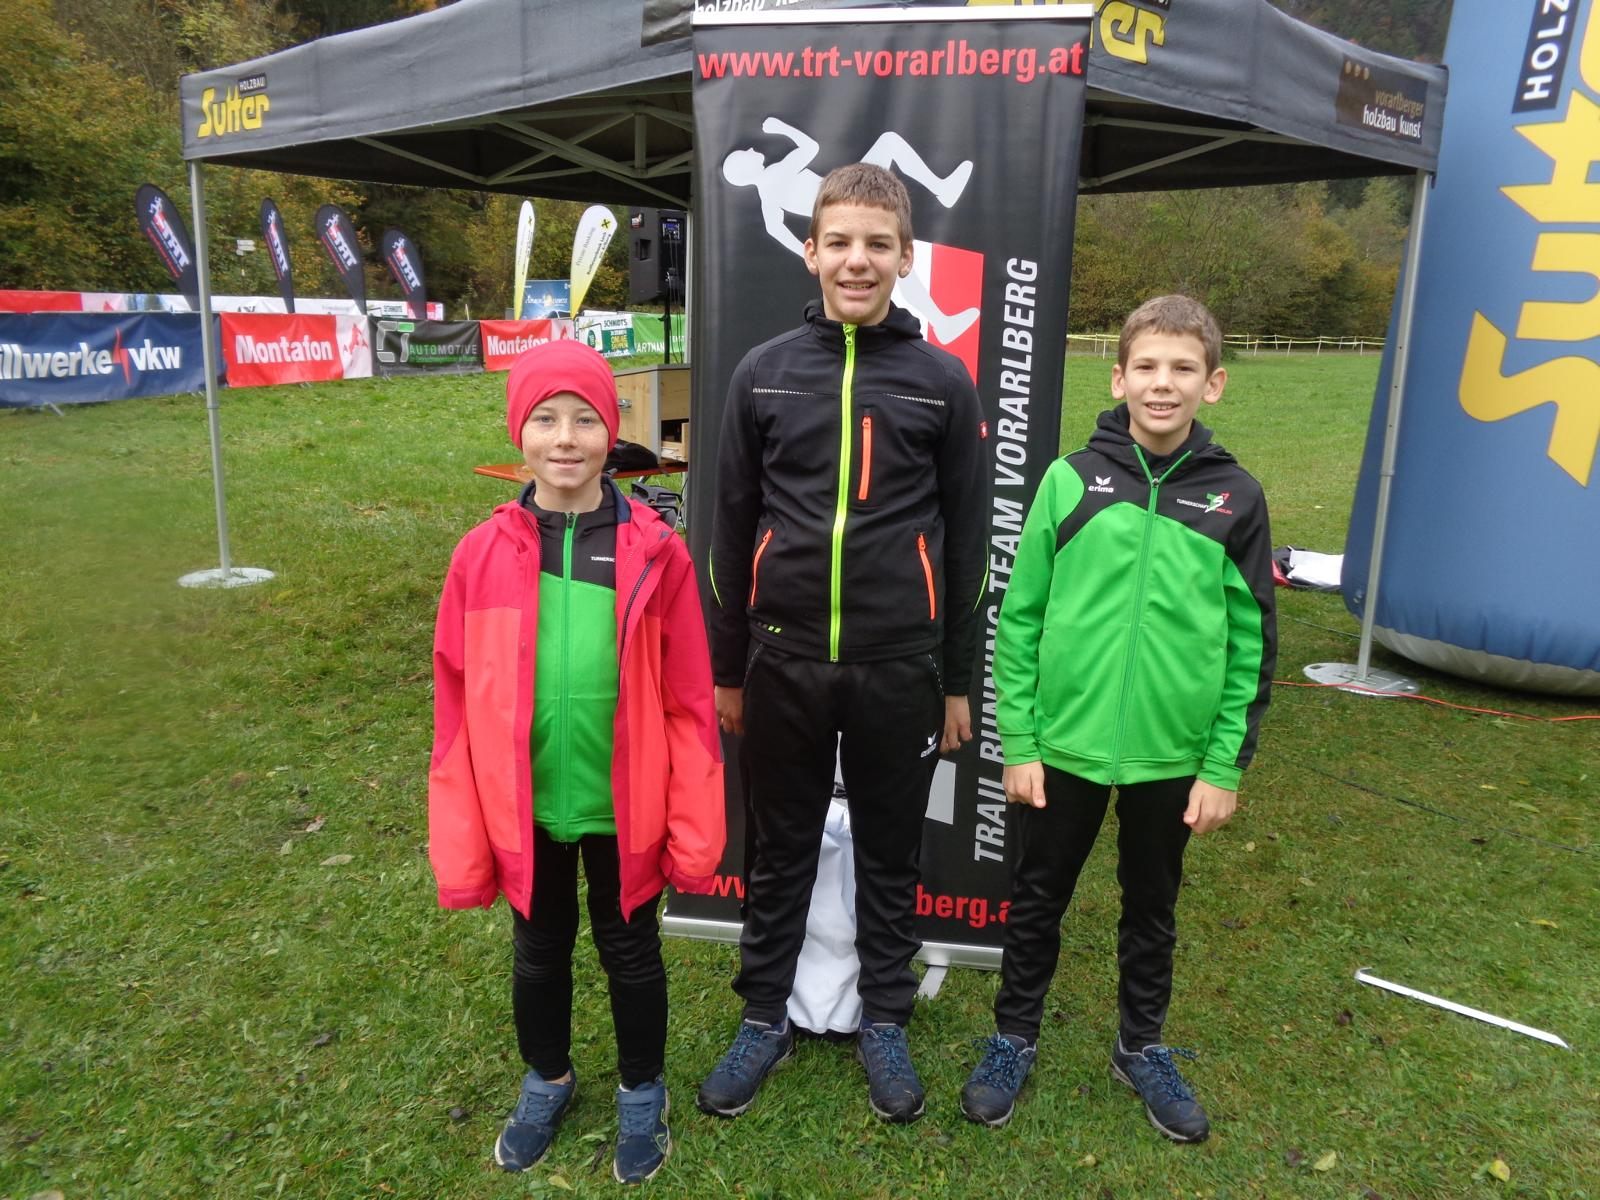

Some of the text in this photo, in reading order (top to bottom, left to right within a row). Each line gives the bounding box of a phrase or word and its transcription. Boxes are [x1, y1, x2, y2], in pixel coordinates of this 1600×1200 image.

[698, 40, 1083, 83] www.trt-vorarlberg.at
[239, 76, 267, 92] HOLZBAU
[197, 85, 270, 138] Sutter
[1362, 103, 1422, 139] holzbau kunst
[1375, 88, 1425, 118] vorarlberger
[1458, 0, 1600, 489] Sutt
[0, 342, 113, 380] llwerke
[128, 338, 181, 372] vkw
[235, 334, 334, 365] Montafon
[408, 344, 478, 356] AUTOMOTIVE
[994, 257, 1038, 486] VORARLBERG
[1088, 484, 1114, 493] erima
[988, 496, 1023, 592] TEAM
